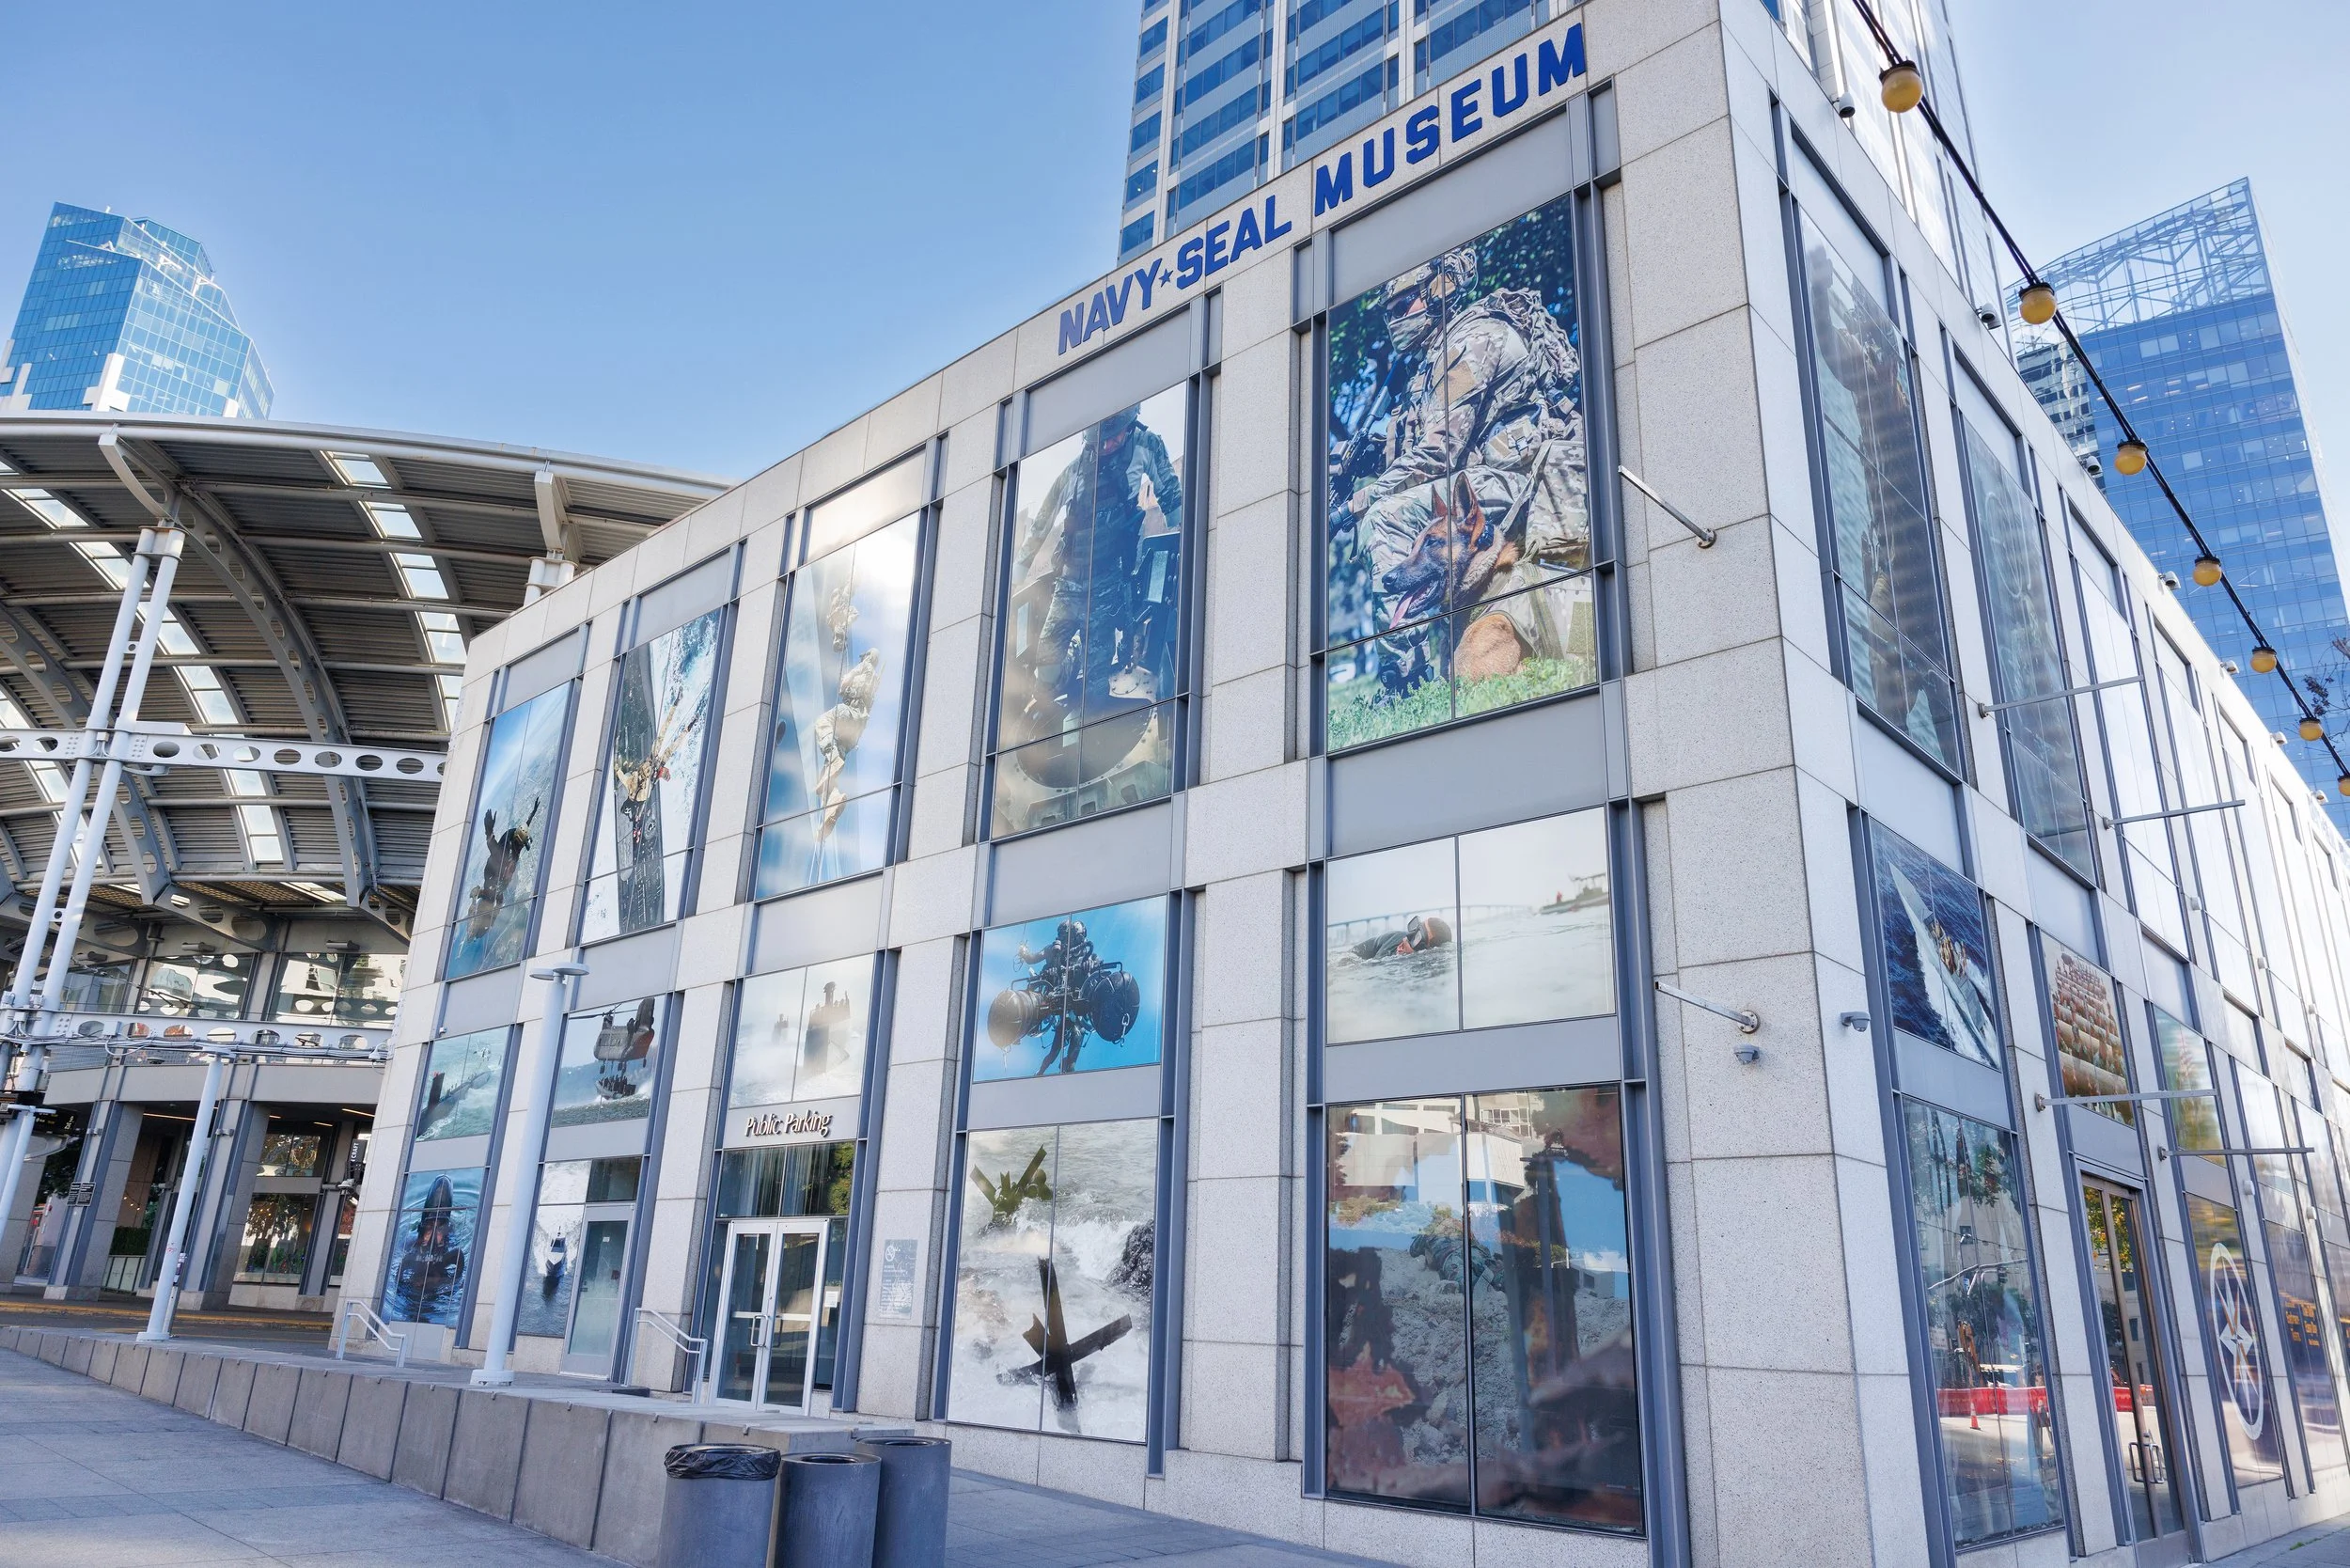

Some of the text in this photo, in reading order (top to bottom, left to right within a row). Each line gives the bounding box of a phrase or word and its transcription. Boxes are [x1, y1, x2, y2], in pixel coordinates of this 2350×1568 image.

[1058, 23, 1586, 355] NAVY SEAL MUSEUM
[745, 1109, 833, 1137] Public Parking
